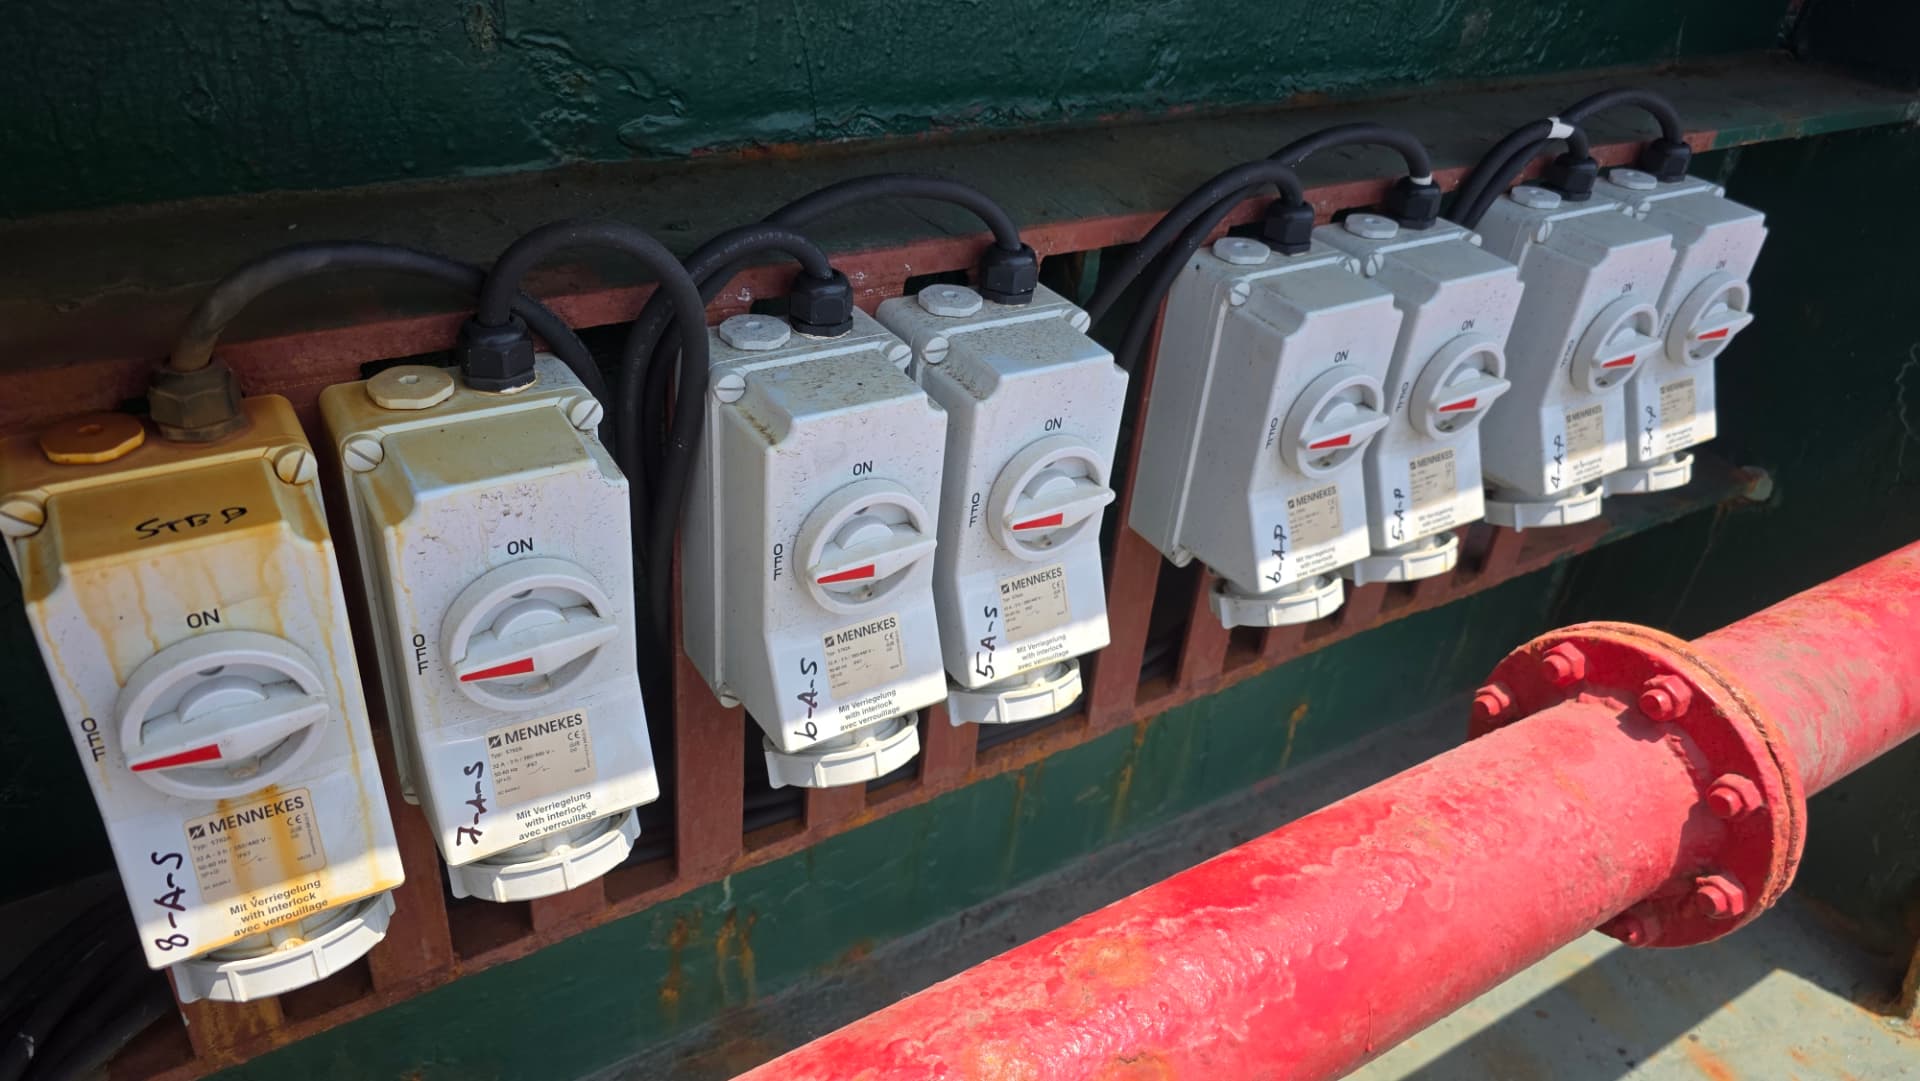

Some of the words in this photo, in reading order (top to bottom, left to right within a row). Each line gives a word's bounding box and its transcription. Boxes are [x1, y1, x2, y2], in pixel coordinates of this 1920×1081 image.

[1622, 280, 1634, 293] ON
[1461, 319, 1475, 331] ON
[1334, 350, 1349, 363] ON
[1396, 381, 1410, 414] OFF
[1044, 417, 1062, 432] ON
[1266, 417, 1278, 450] OFF
[852, 461, 873, 476] ON
[1551, 434, 1564, 489] 4-A-P
[969, 492, 980, 528] OFF
[1296, 486, 1336, 507] MENNEKES
[507, 537, 534, 555] ON
[773, 543, 783, 581] OFF
[1266, 524, 1288, 584] 6-A-P
[1011, 567, 1063, 592] MENNEKES
[187, 609, 220, 630] ON
[837, 617, 897, 645] MENNEKES
[412, 633, 428, 675] OFF
[976, 605, 998, 679] 5-A-S
[794, 657, 818, 740] 6-A-S
[838, 705, 852, 713] Mit
[81, 717, 106, 761] OFF
[505, 713, 583, 745] MENNEKES
[840, 721, 857, 731] avec
[209, 796, 305, 835] MENNEKES
[456, 760, 487, 846] 7-A-S
[516, 810, 531, 820] Mit
[533, 791, 592, 814] Verriegelung
[525, 816, 545, 828] with
[547, 803, 588, 820] interlock
[519, 829, 541, 841] avec
[543, 809, 597, 832] verrouillage
[151, 851, 189, 951] 8-A-S
[230, 905, 248, 916] Mit
[250, 879, 322, 908] Verriegelung
[240, 911, 265, 923] with
[268, 893, 316, 915] interlock
[234, 923, 261, 937] avec
[263, 899, 328, 926] verrouillage
